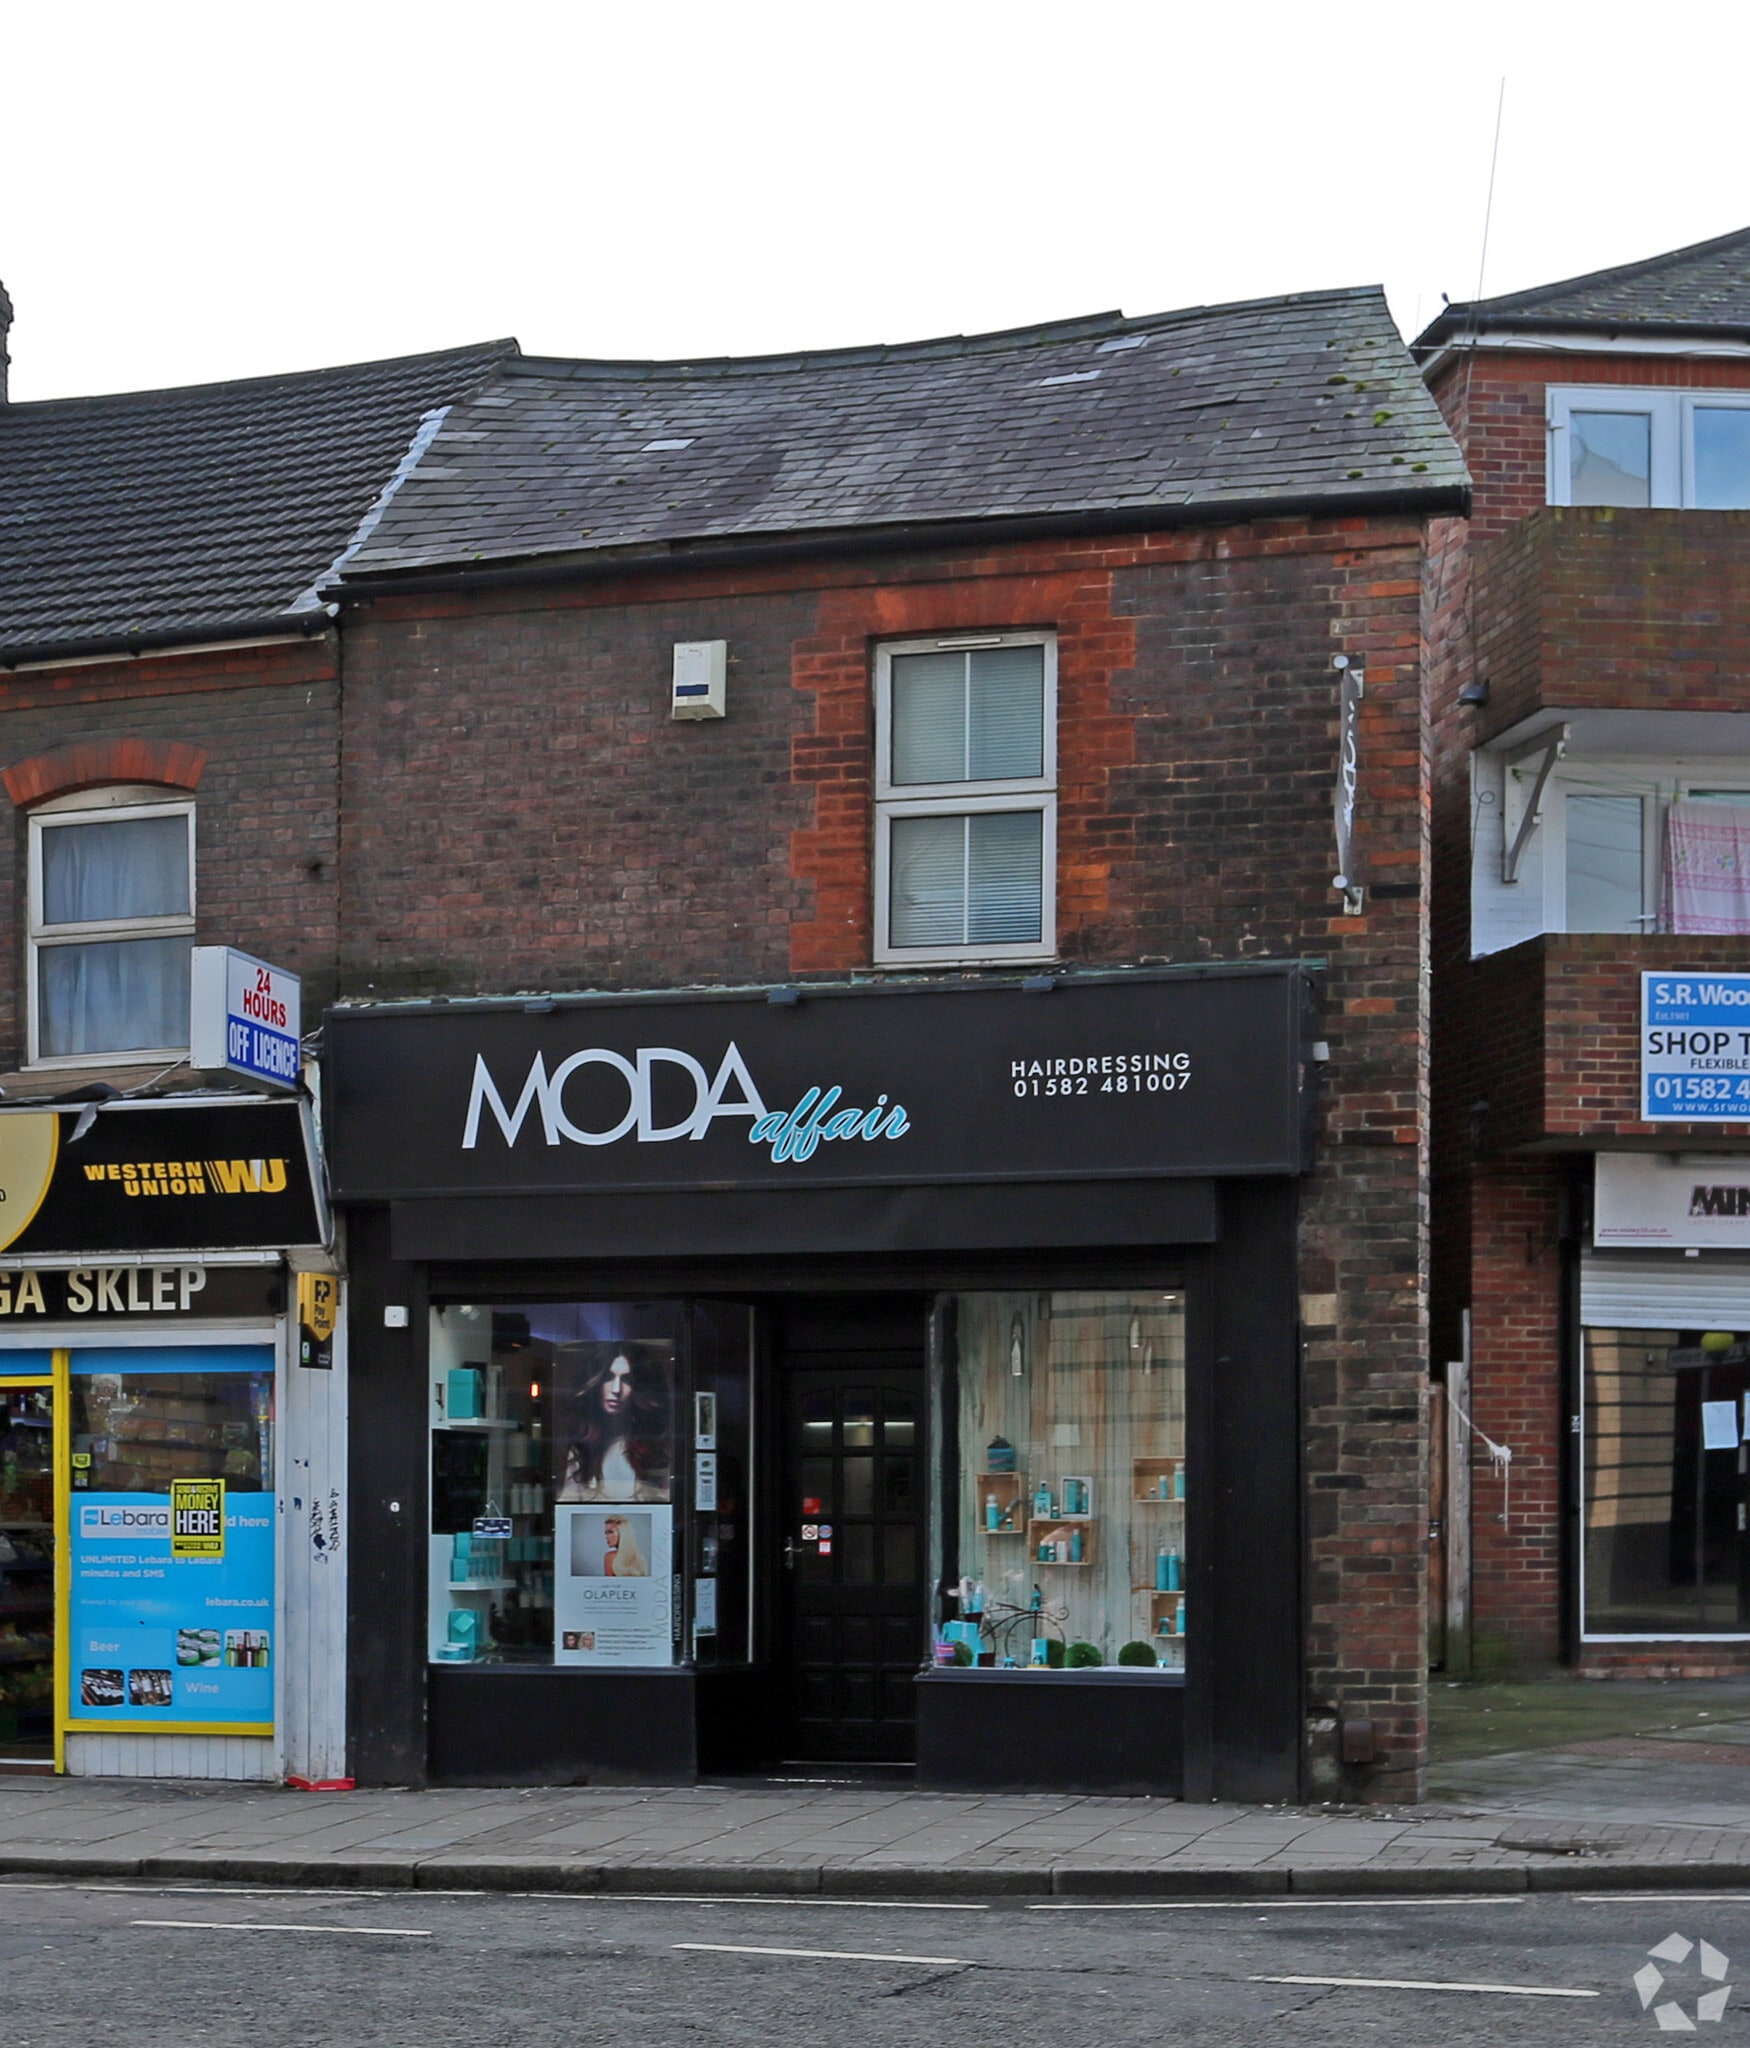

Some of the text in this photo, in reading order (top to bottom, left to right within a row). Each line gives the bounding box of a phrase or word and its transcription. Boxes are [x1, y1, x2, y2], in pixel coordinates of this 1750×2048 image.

[257, 968, 271, 996] 24
[243, 988, 286, 1027] HOURS
[229, 1022, 296, 1078] OFF LICENCE
[1648, 1031, 1730, 1055] SHOP
[1011, 1052, 1190, 1077] HAIRDRESSING
[1690, 1058, 1749, 1070] FLEXIBLE
[1014, 1073, 1191, 1097] 01582 481007
[1654, 1077, 1731, 1100] 01582
[461, 1041, 910, 1163] MODA affair
[84, 1162, 203, 1180] WESTERN
[213, 1158, 287, 1193] WU
[124, 1179, 206, 1196] UNION
[67, 1267, 206, 1313] SKLEP
[176, 1494, 219, 1510] MONEY
[101, 1509, 168, 1526] Lebara
[239, 1515, 270, 1527] here
[176, 1510, 219, 1534] HERE
[80, 1555, 137, 1565] UNLIMITED
[138, 1555, 173, 1565] Lebara
[80, 1569, 165, 1578] minutes and SMS
[583, 1589, 637, 1600] OLAPLEX
[89, 1641, 119, 1652] Beer
[185, 1681, 219, 1693] Wine
